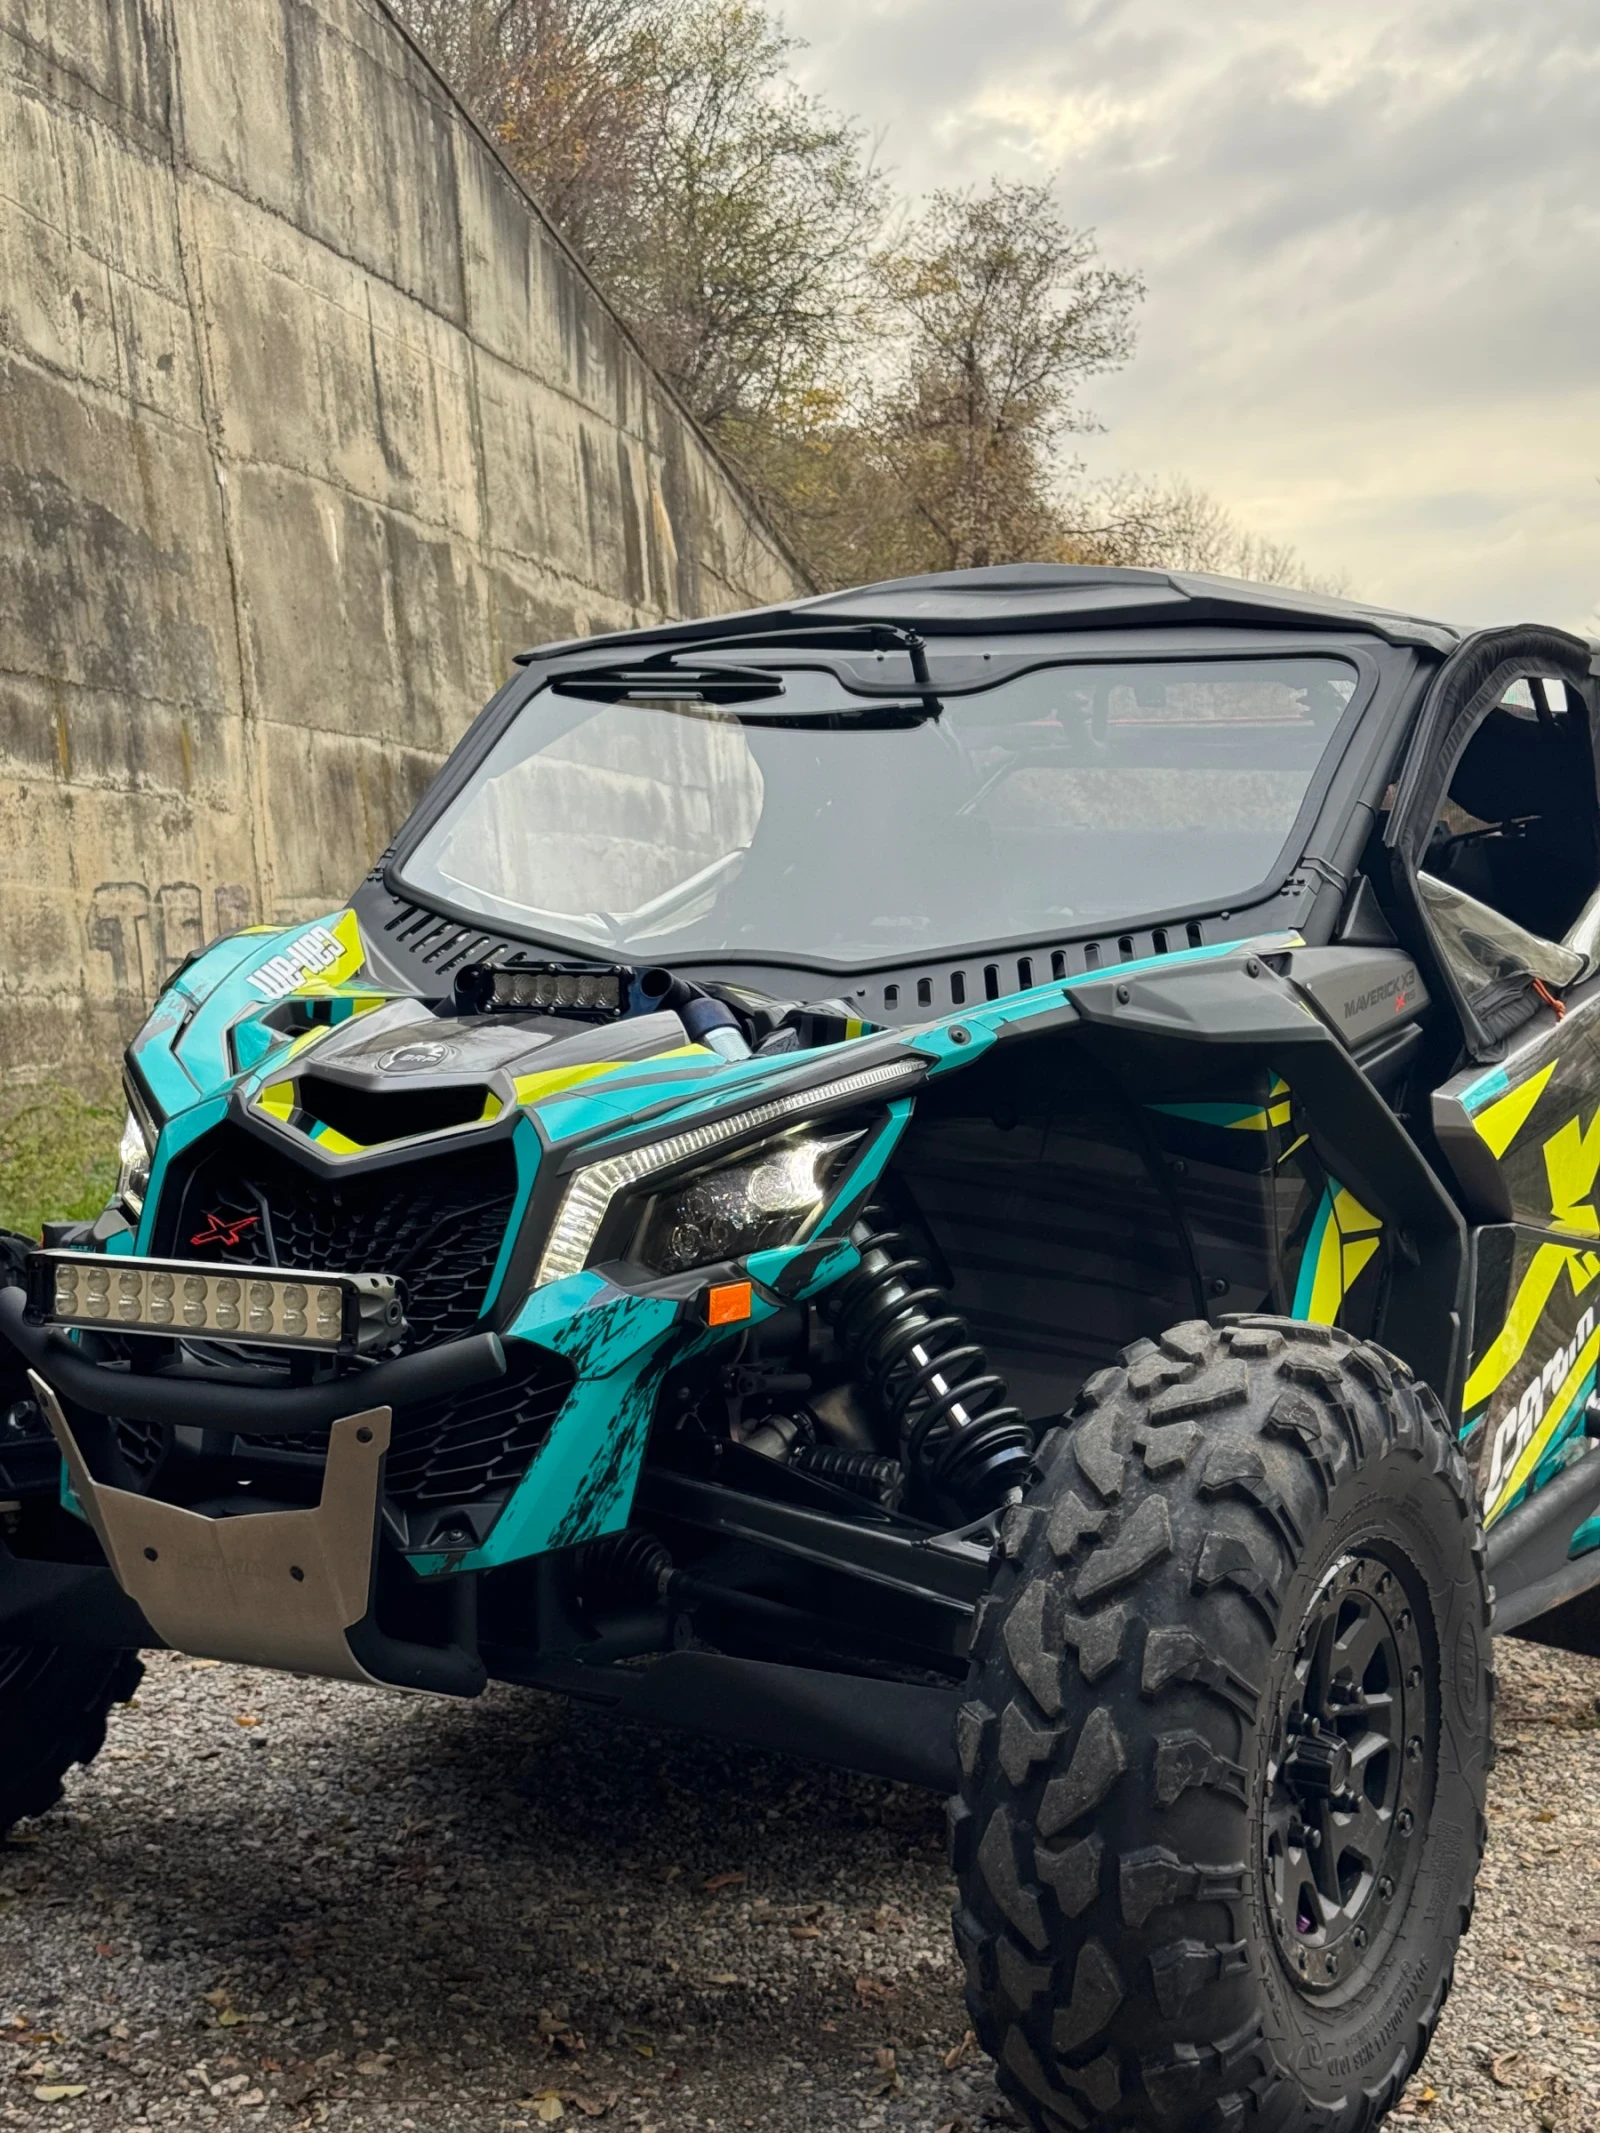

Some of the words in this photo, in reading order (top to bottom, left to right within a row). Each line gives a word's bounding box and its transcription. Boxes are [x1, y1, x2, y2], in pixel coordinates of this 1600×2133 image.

[1344, 975, 1400, 1019] MAVERICK
[1400, 968, 1416, 990] X3
[399, 1053, 438, 1063] BRP
